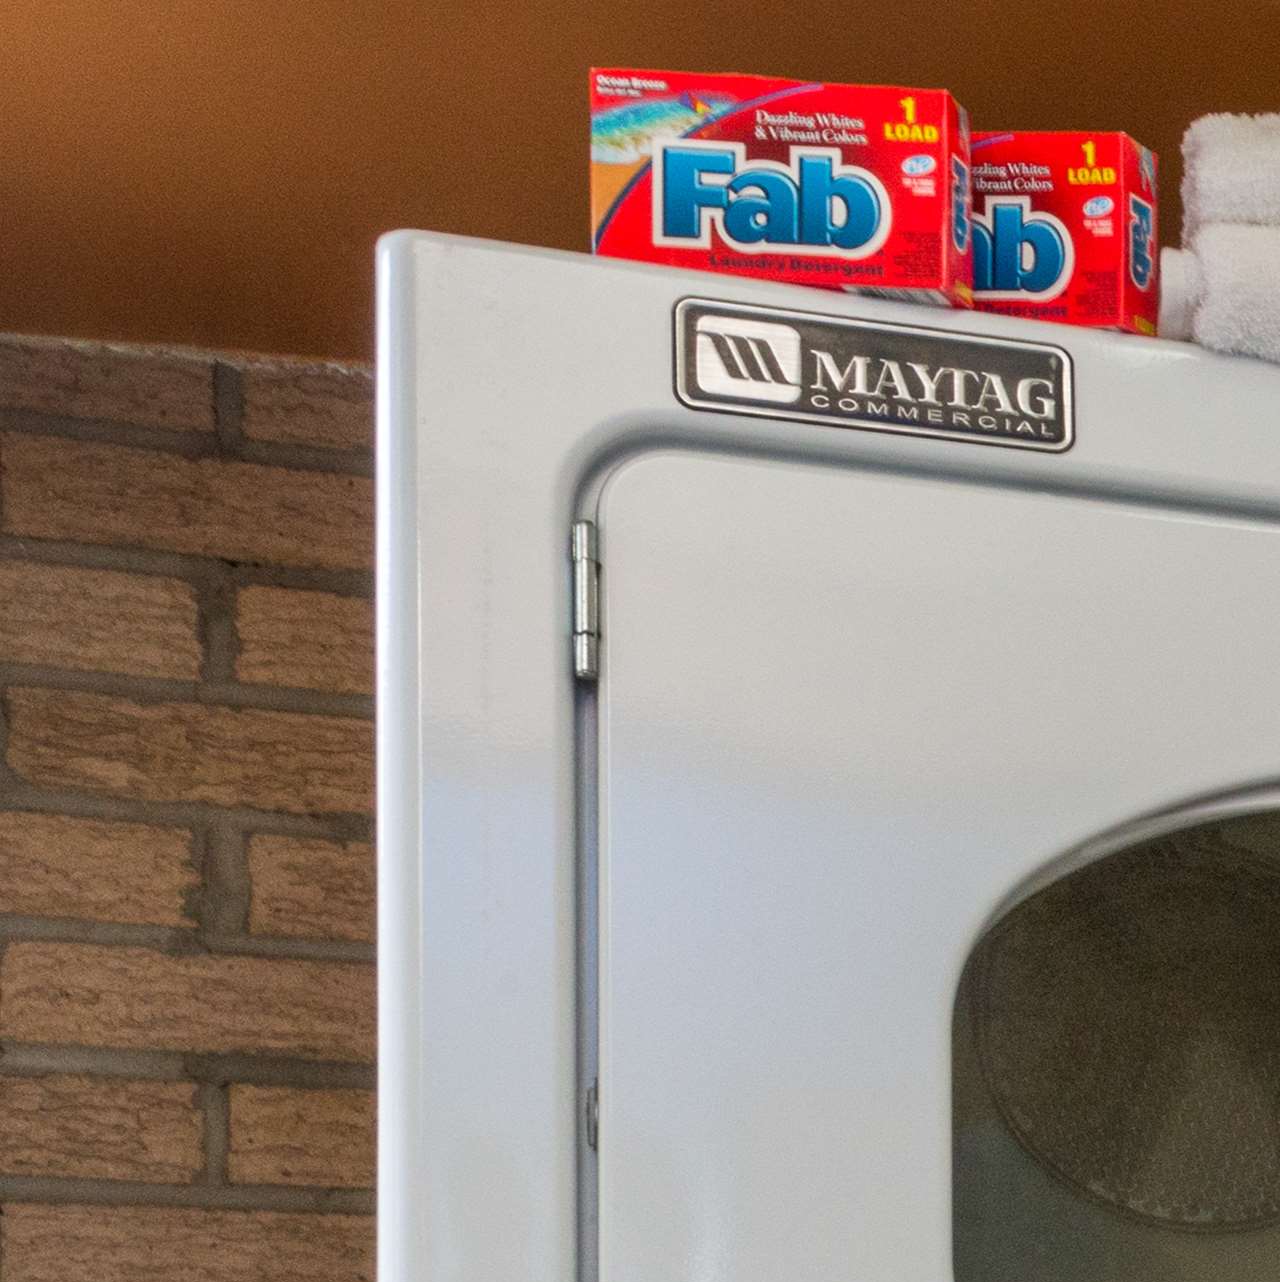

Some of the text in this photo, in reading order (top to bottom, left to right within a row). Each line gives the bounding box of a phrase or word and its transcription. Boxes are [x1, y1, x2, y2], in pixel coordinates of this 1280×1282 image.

[755, 109, 865, 130] Dazzling Whites
[901, 96, 917, 124] 1
[755, 126, 868, 145] & Vibrant Colors
[883, 123, 939, 143] LOAD
[1081, 141, 1097, 168] 1
[1007, 162, 1051, 177] Whites
[1067, 166, 1117, 186] LOAD
[975, 177, 1054, 192] ibrant Colors
[659, 144, 884, 251] Fab
[809, 349, 1057, 422] MAYTAG
[809, 394, 1056, 437] COMMERCIAL
